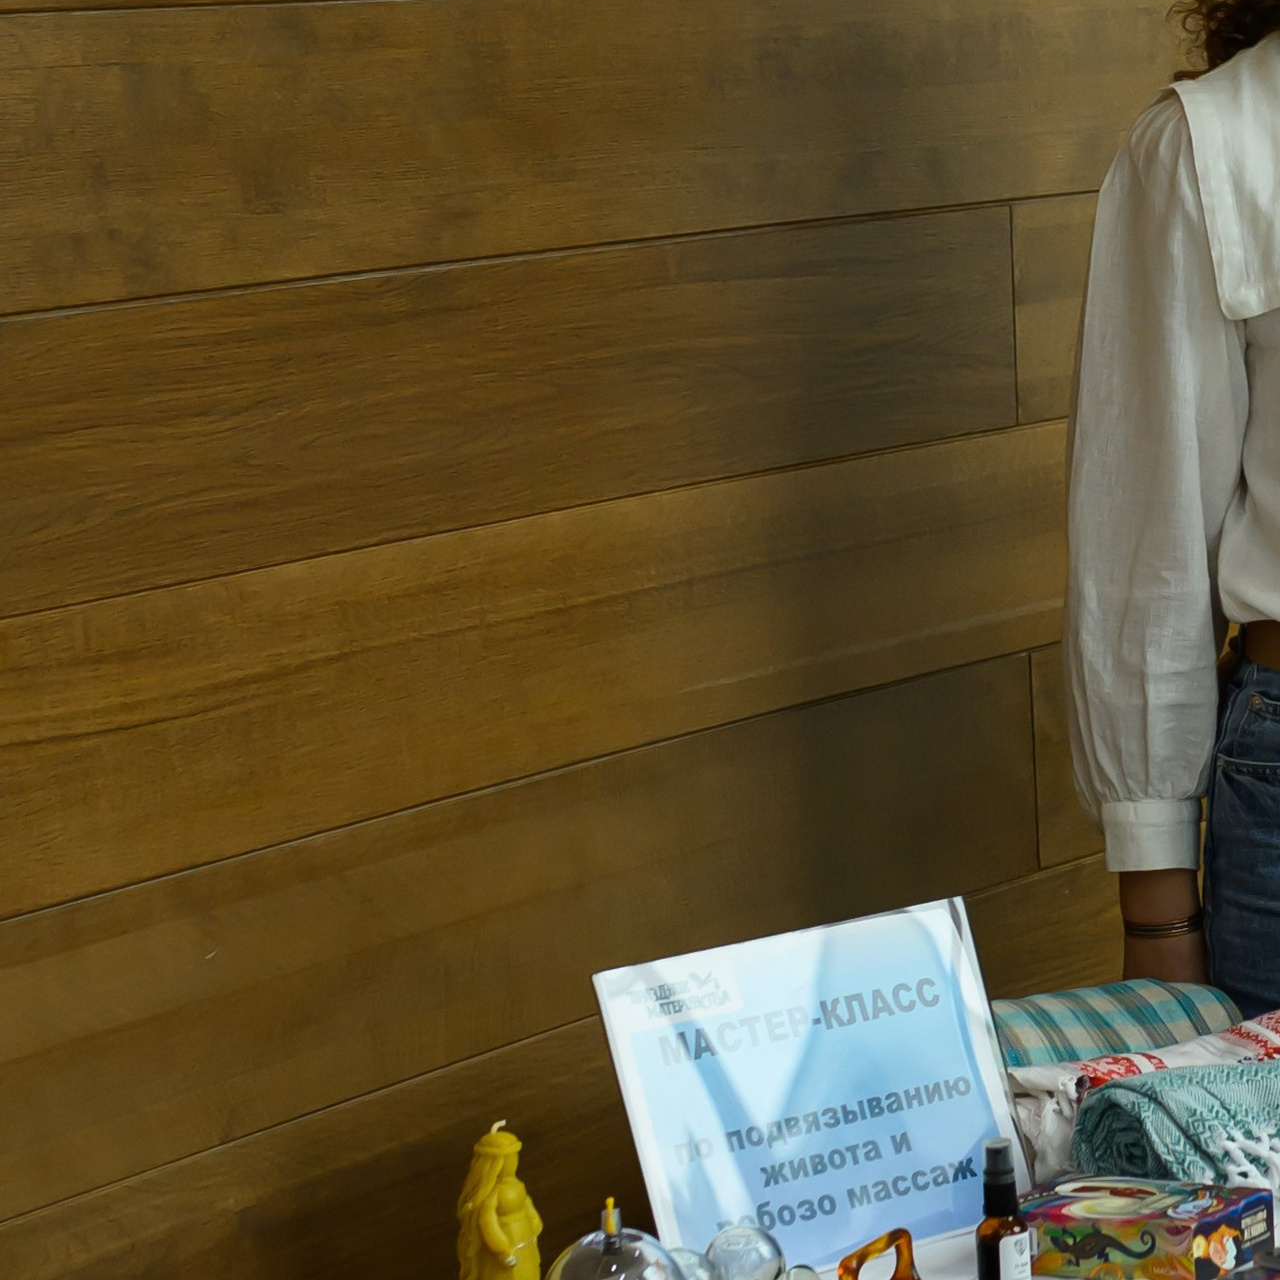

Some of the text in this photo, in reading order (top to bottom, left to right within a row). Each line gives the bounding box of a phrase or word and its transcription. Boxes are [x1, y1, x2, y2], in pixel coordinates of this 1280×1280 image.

[658, 978, 940, 1065] МАСТЕР-КЛАСС
[674, 1076, 971, 1165] по подвязыванию
[760, 1131, 912, 1188] живота и
[847, 1157, 977, 1208] массаж
